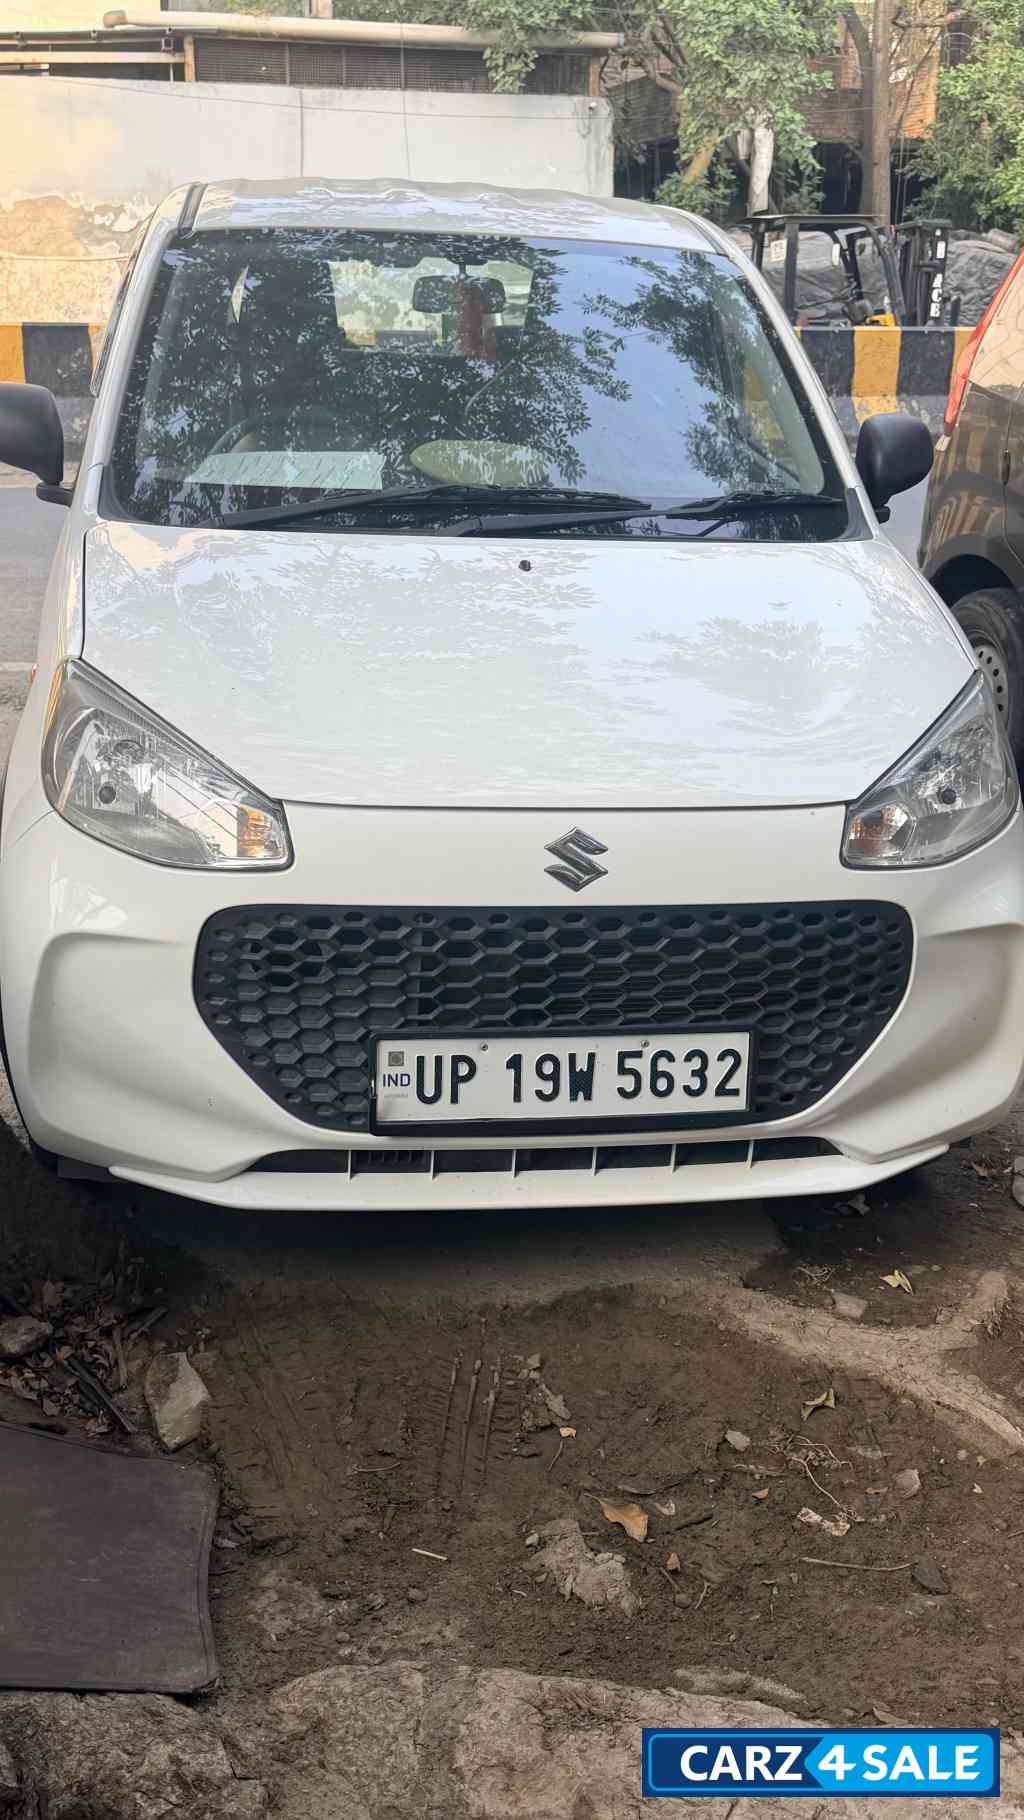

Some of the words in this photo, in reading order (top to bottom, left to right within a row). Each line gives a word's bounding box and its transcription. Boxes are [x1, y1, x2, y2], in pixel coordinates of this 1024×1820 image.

[382, 1073, 411, 1087] IND
[416, 1054, 477, 1105] UP
[505, 1051, 597, 1103] 19W
[616, 1048, 743, 1099] 5632
